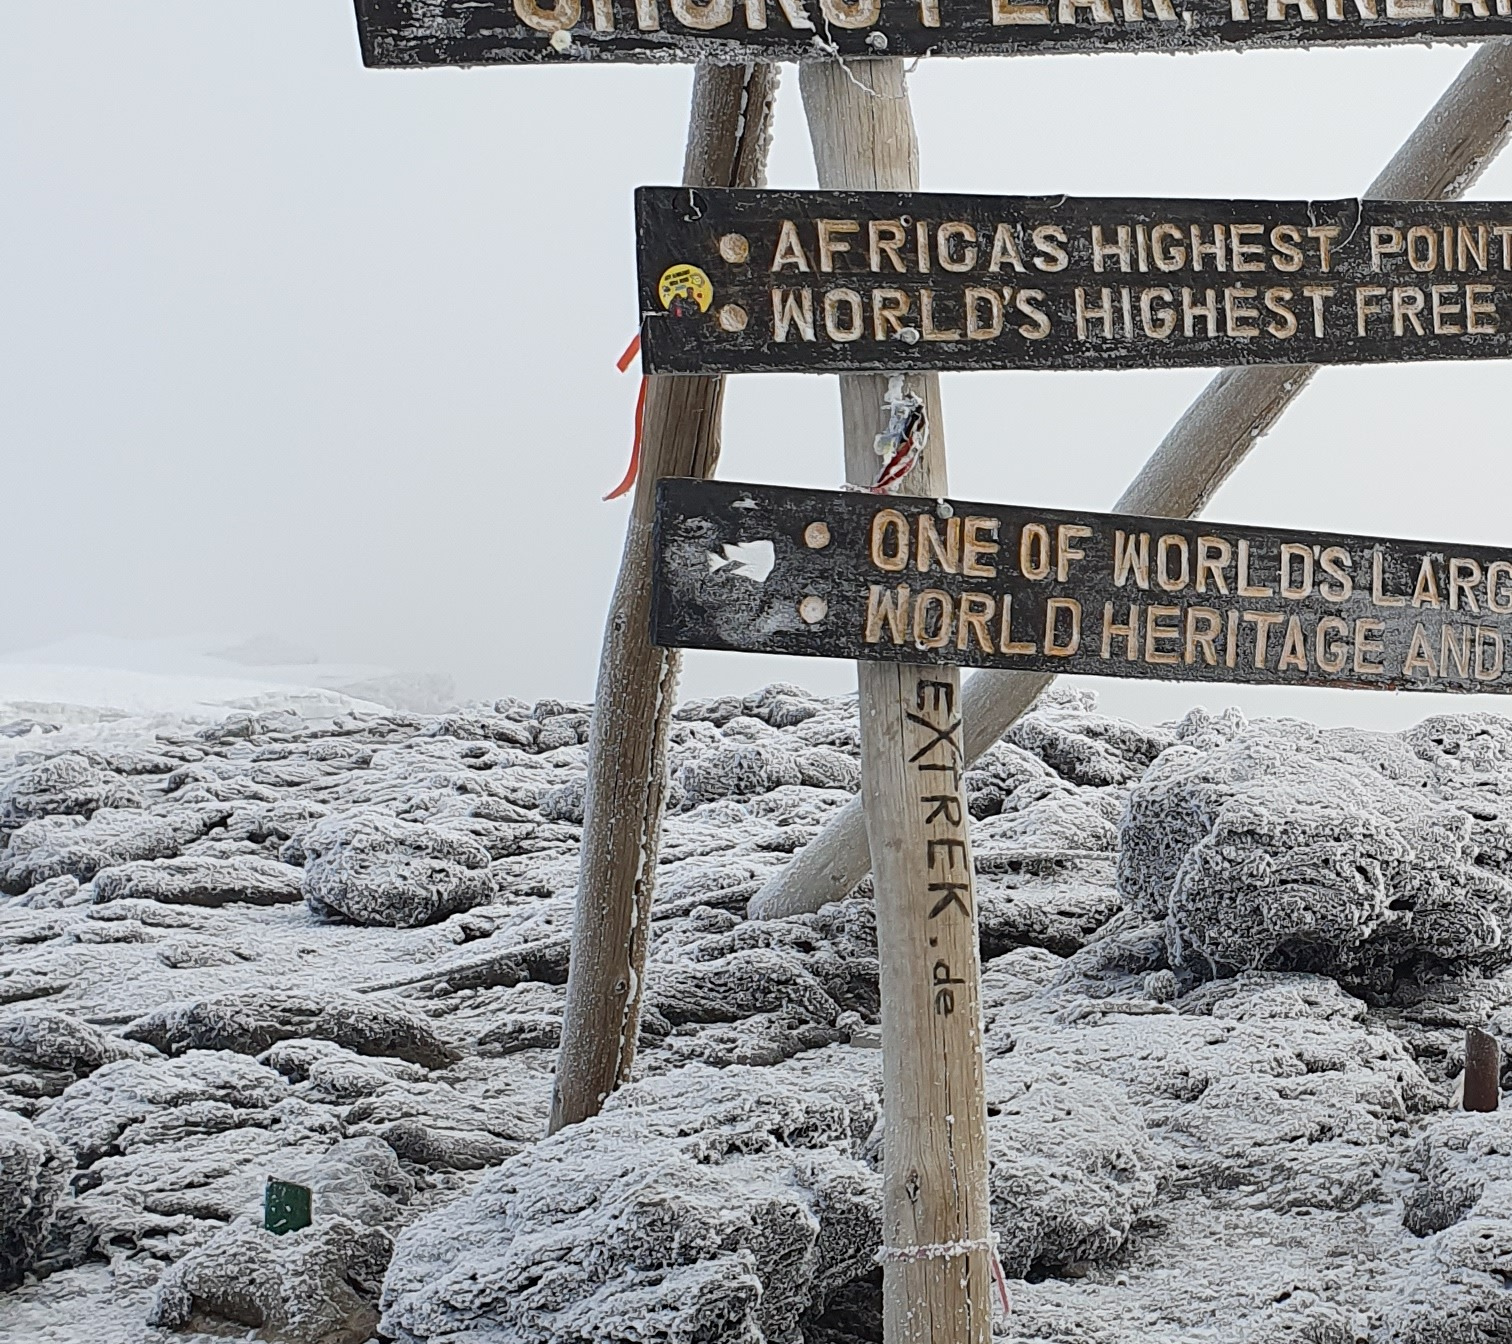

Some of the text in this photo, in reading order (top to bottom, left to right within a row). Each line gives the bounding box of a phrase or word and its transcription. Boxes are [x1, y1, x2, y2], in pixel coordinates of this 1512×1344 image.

[1093, 224, 1339, 273] HIGHEST
[772, 287, 1053, 342] WORLD'S
[1076, 286, 1335, 339] HIGHEST
[1356, 284, 1499, 336] FREE
[871, 509, 998, 578] ONE
[1021, 522, 1093, 583] OF
[1113, 529, 1354, 602] WORLD'S
[864, 584, 1081, 656] WORLD
[1100, 601, 1387, 676] HERITAGE
[1403, 622, 1502, 679] AND
